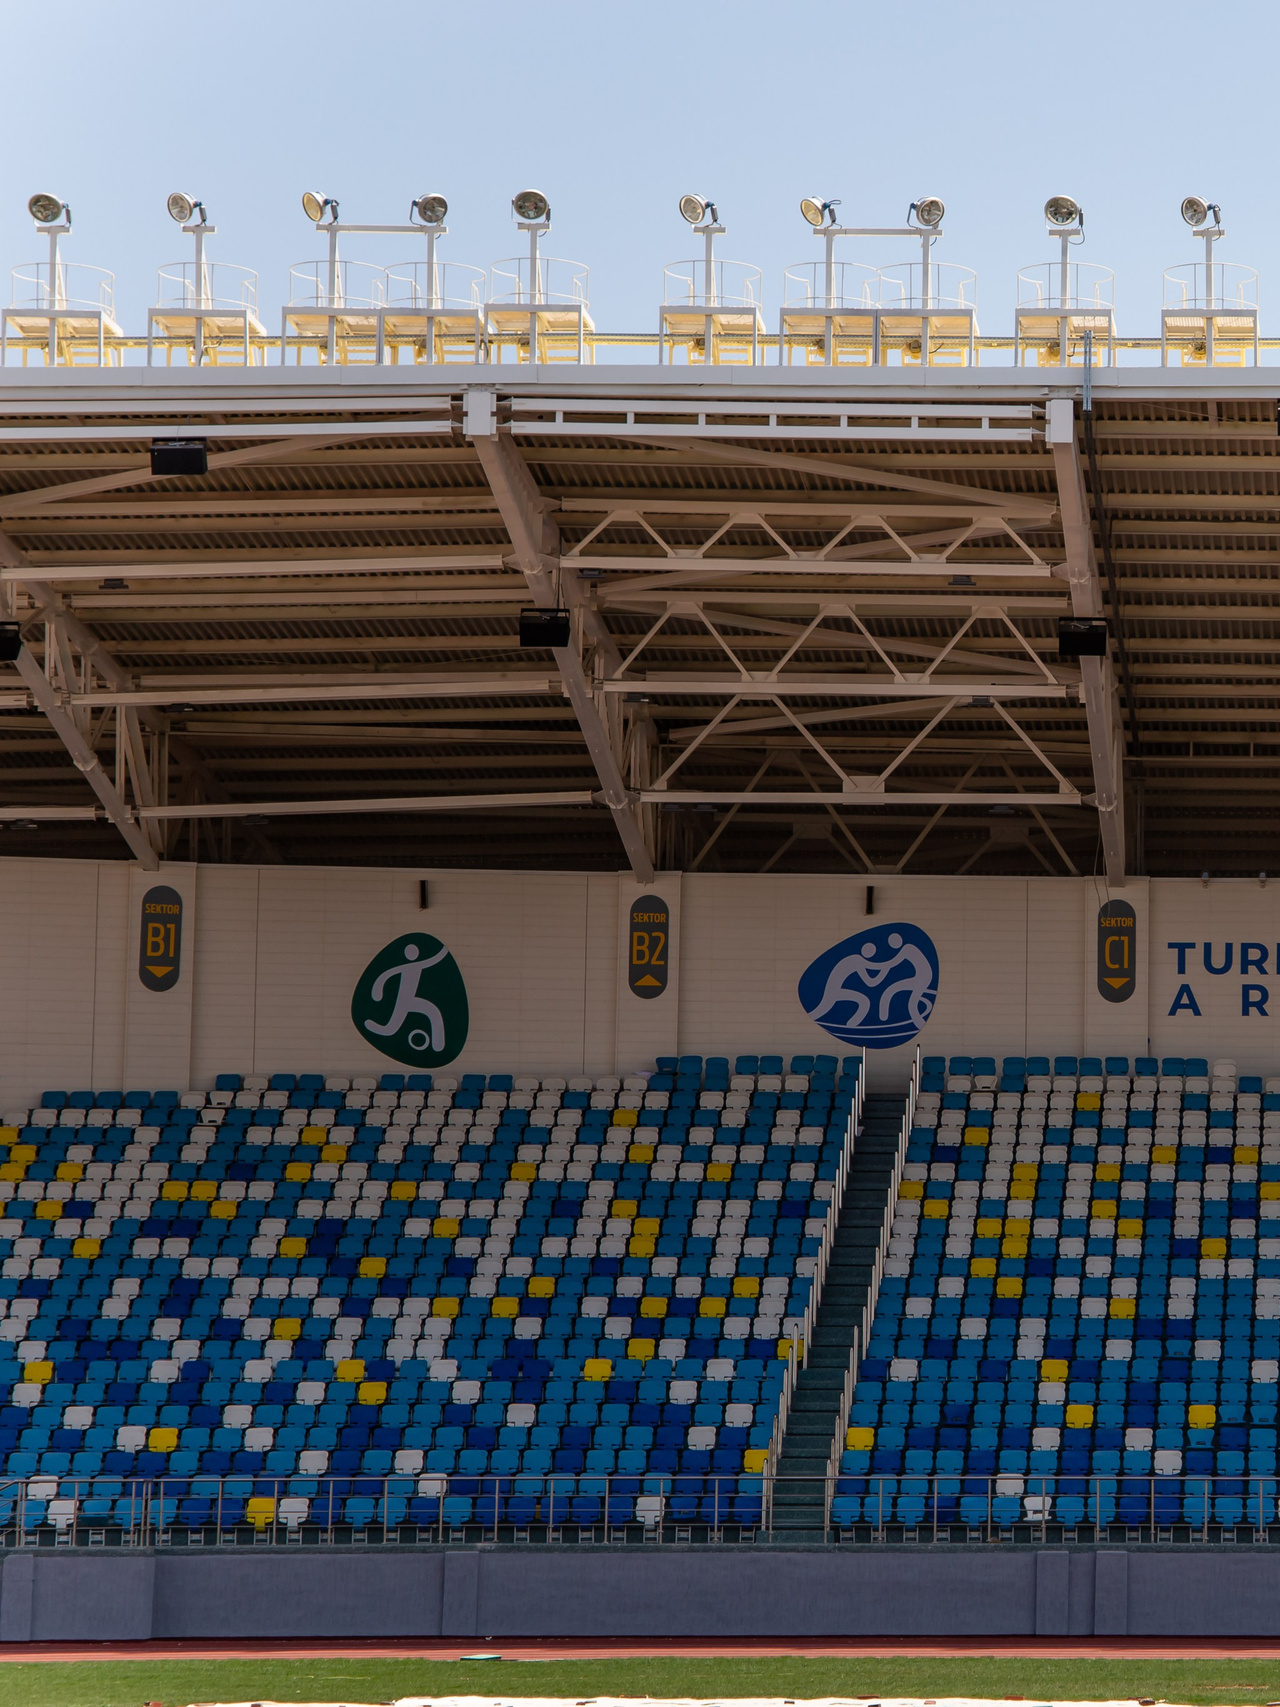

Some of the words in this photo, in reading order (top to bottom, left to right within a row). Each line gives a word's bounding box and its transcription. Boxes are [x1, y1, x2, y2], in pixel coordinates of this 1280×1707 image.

[145, 903, 180, 915] SEKTOR
[633, 912, 667, 923] SEKTOR
[1100, 917, 1134, 928] SEKTOR
[146, 922, 175, 957] B1
[633, 931, 666, 965] B2
[1104, 935, 1129, 969] C1
